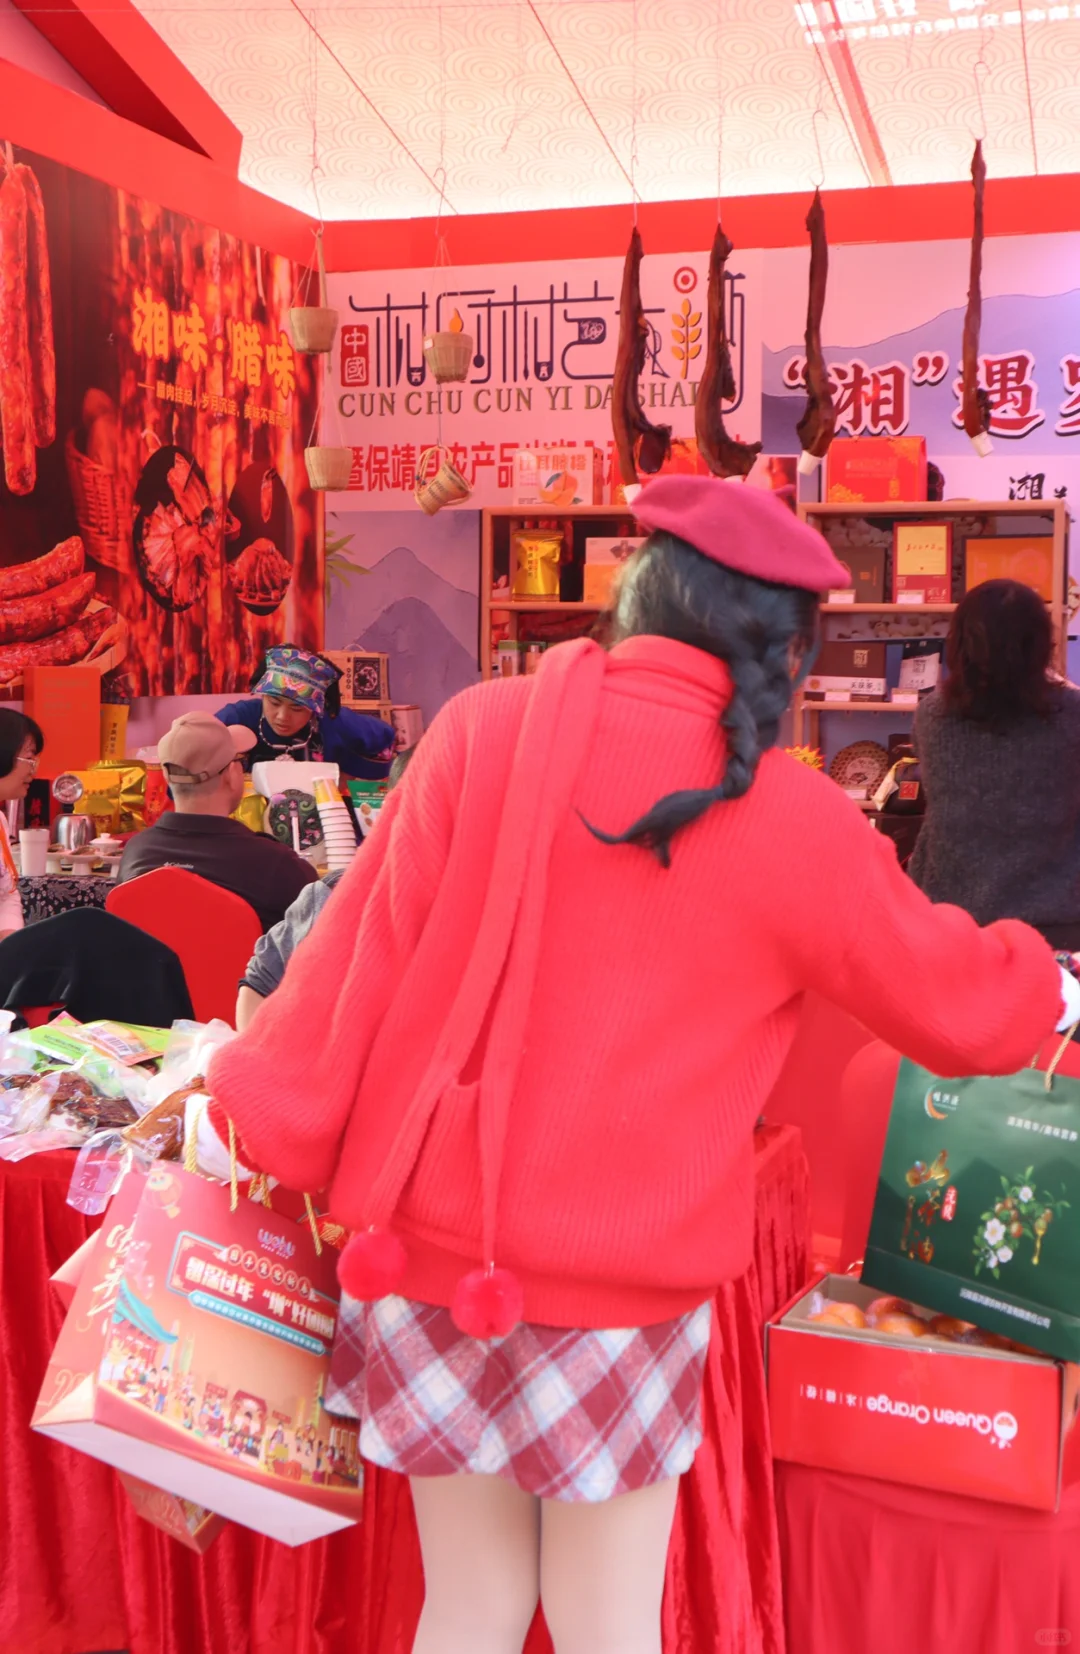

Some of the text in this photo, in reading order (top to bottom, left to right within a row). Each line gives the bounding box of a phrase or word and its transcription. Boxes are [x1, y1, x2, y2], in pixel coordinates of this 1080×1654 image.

[338, 393, 396, 418] CUN
[404, 390, 463, 416] CHU
[473, 387, 532, 413] CUN
[546, 386, 573, 411] YI
[866, 1394, 930, 1424] Orange
[933, 1407, 992, 1435] Queen
